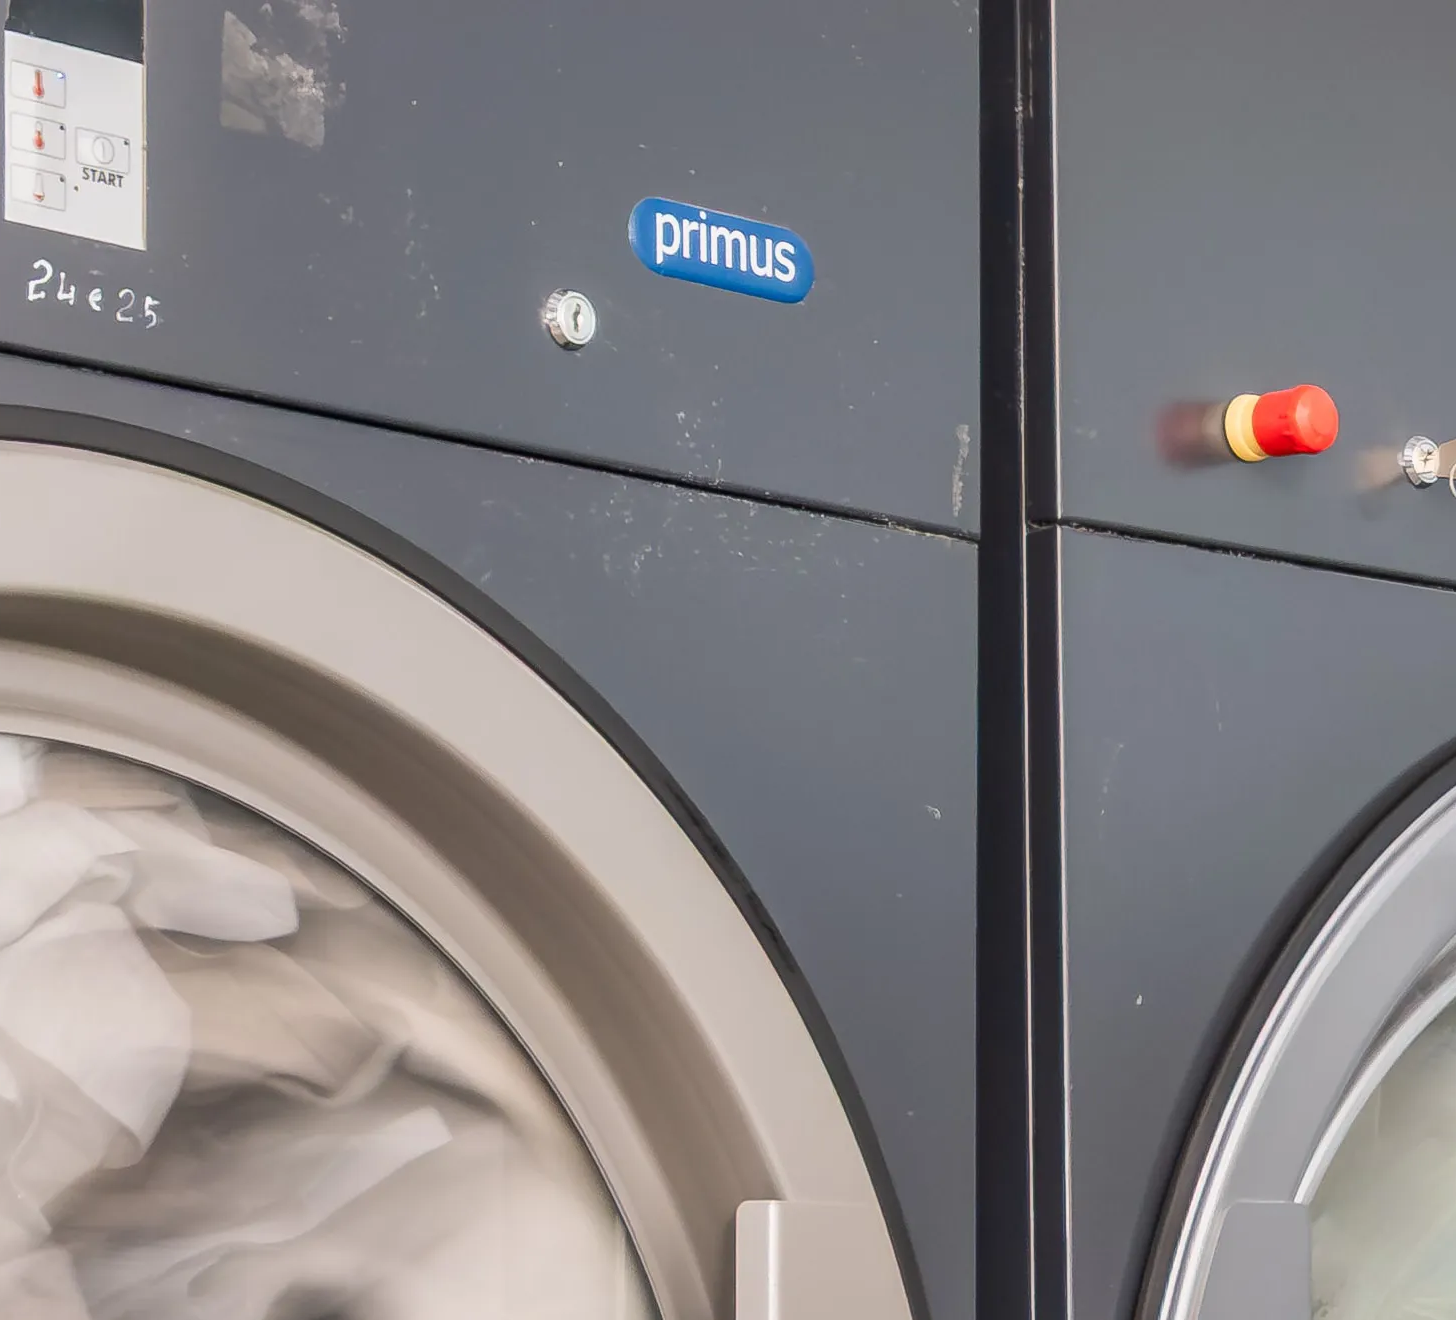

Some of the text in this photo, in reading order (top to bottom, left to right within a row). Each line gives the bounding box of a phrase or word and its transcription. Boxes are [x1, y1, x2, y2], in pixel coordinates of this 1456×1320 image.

[82, 167, 125, 188] START
[655, 211, 796, 283] primus
[27, 259, 76, 306] 24
[115, 288, 161, 329] 25
